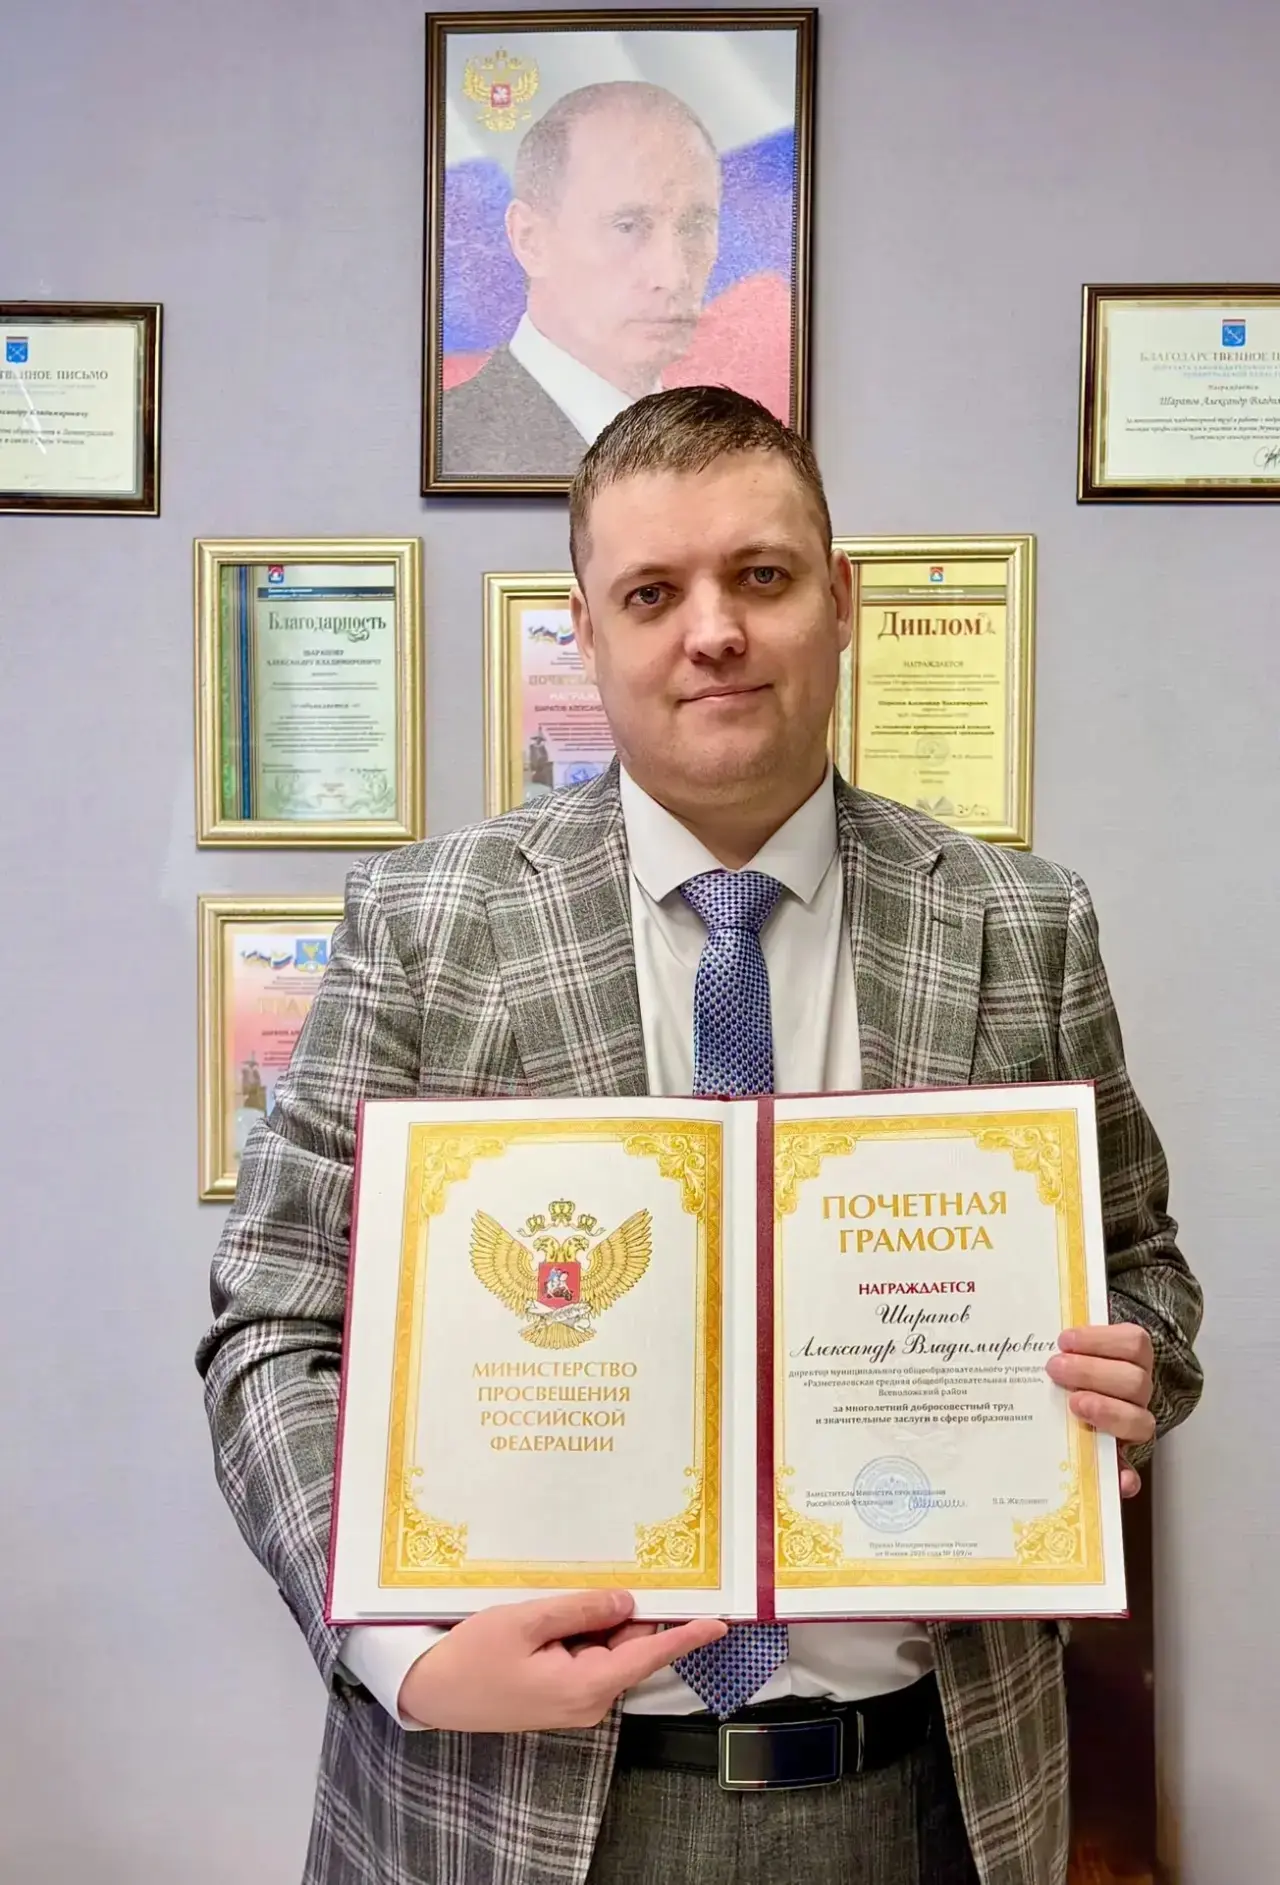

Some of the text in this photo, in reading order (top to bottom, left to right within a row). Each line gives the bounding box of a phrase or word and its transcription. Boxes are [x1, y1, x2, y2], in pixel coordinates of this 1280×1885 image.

[1140, 352, 1267, 361] БЛАГОДАРСТВЕННОЕ
[57, 370, 109, 380] ПИСЬМО
[268, 611, 387, 642] Благодарность
[878, 611, 982, 641] Диплом
[822, 1191, 1007, 1220] ПОЧЕТНАЯ
[839, 1226, 994, 1254] ГРАМОТА
[858, 1281, 976, 1296] НАГРАЖДАЕТСЯ
[875, 1304, 972, 1332] Шарапов
[789, 1333, 1056, 1364] Александр Владимирович
[472, 1362, 638, 1378] МИНИСТЕРСТВО
[788, 1369, 829, 1379] директор
[831, 1367, 901, 1377] муниципального
[903, 1366, 1003, 1375] общеобразовательного
[876, 1379, 910, 1387] средняя
[912, 1377, 1007, 1386] общеобразовательная
[478, 1387, 631, 1402] ПРОСВЕЩЕНИЯ
[878, 1387, 968, 1397] Всеволожский район
[845, 1403, 908, 1413] многолетний
[910, 1402, 991, 1412] добросовестный
[993, 1402, 1014, 1412] труд
[481, 1408, 626, 1427] РОССИЙСКОЙ
[823, 1416, 892, 1425] значительные
[894, 1414, 931, 1425] заслуги
[940, 1413, 969, 1424] сфере
[971, 1413, 1033, 1423] образования
[490, 1435, 614, 1452] ФЕДЕРАЦИИ
